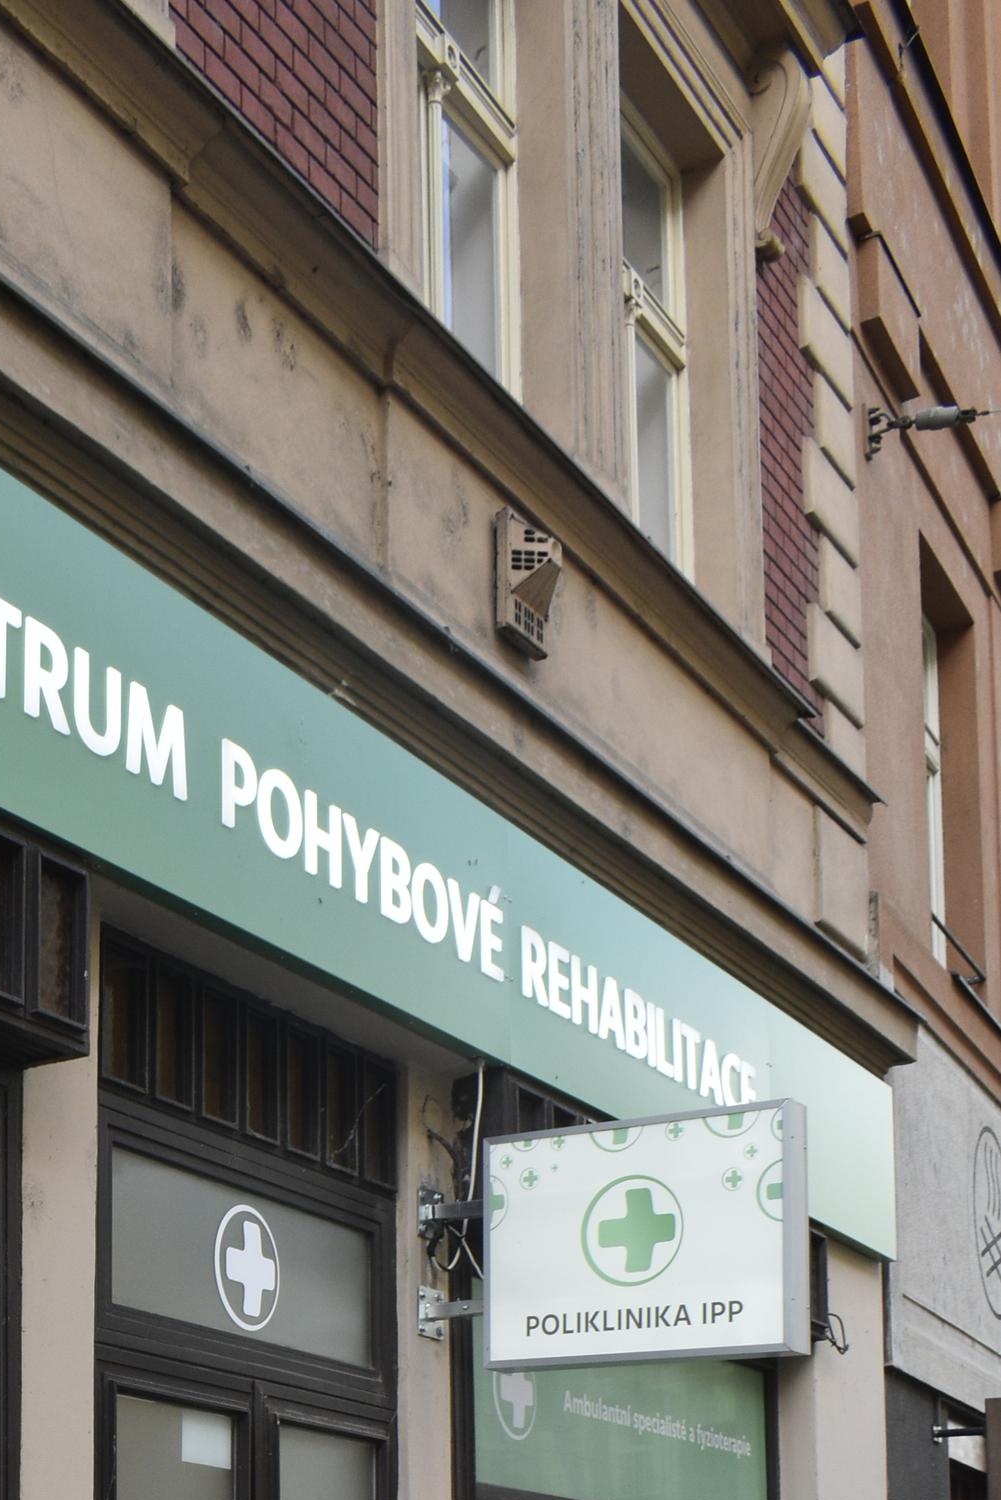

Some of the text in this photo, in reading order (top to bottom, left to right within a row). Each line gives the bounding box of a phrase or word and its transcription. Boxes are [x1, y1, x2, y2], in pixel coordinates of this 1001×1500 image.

[221, 738, 505, 983] POHYBOVÉ
[521, 924, 757, 1107] REHABILITACE
[526, 1300, 744, 1337] POLIKLINIKA IPP
[563, 1390, 751, 1460] Ambulantní specialisté a fyzioterapie
